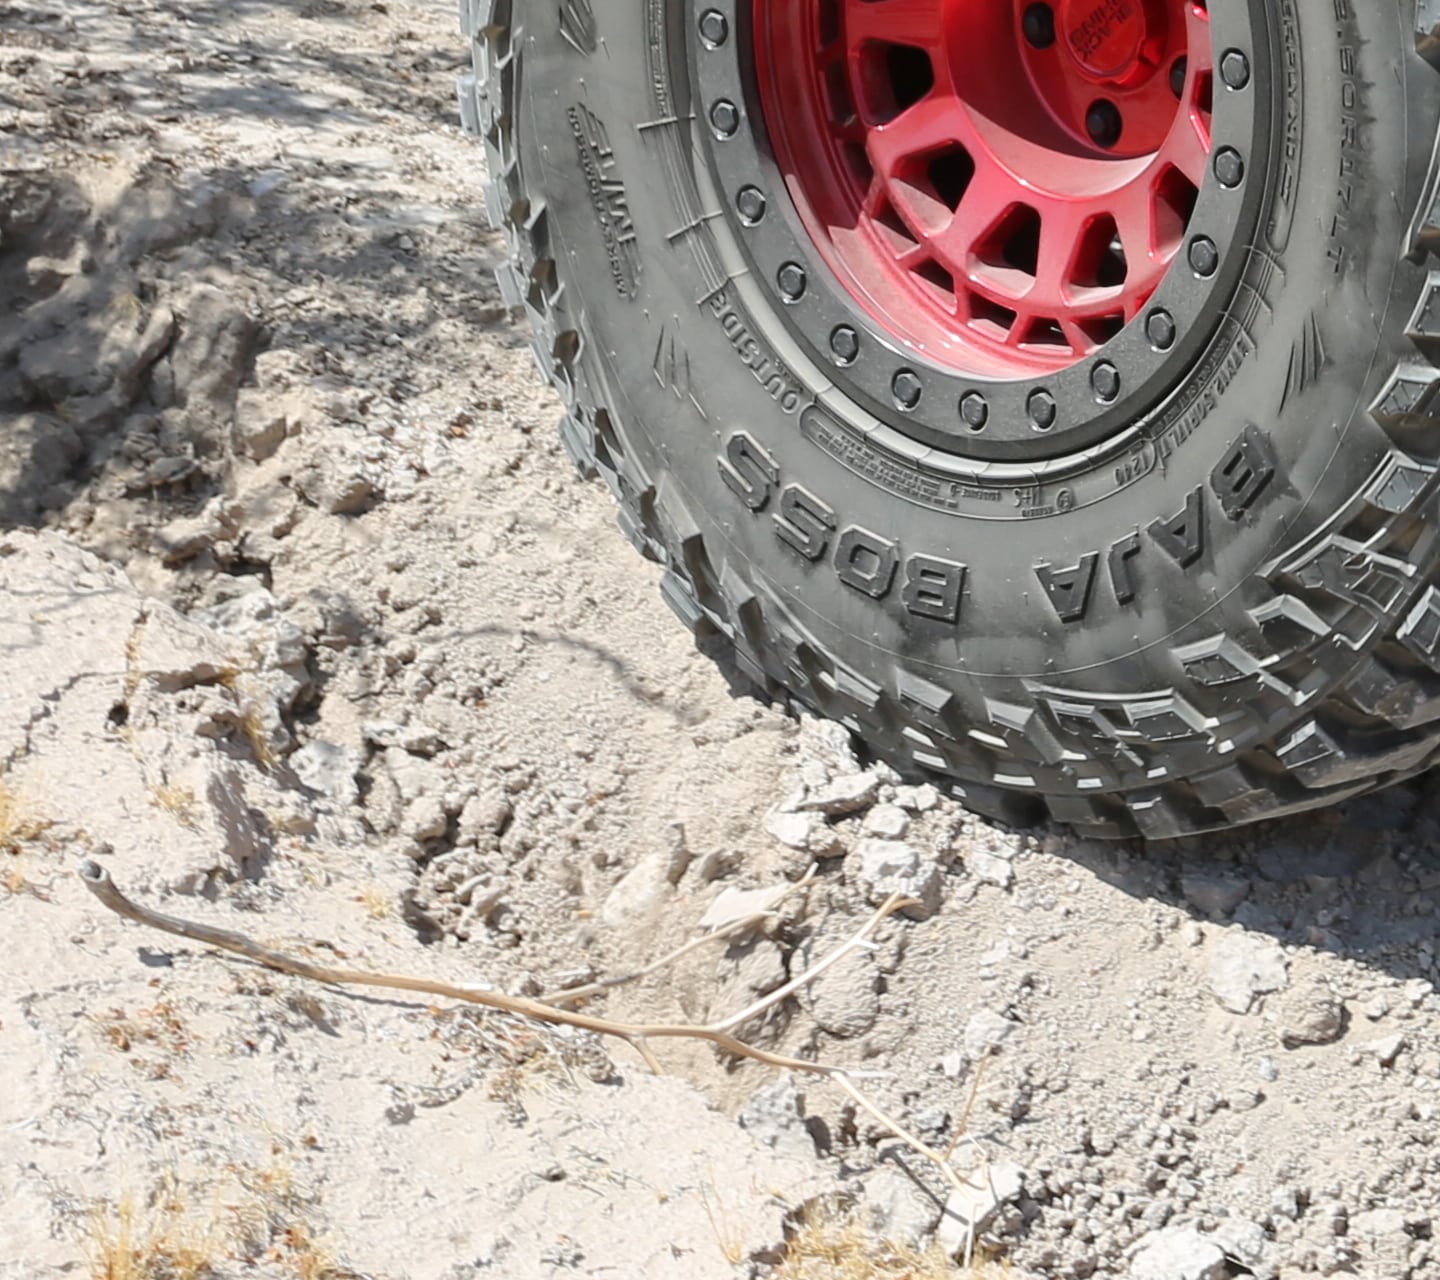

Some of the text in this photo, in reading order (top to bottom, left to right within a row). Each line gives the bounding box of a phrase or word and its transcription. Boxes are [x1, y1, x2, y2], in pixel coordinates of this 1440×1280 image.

[706, 291, 797, 411] OUTSIDE
[716, 430, 968, 624] BOSS
[1034, 427, 1276, 624] BAJA
